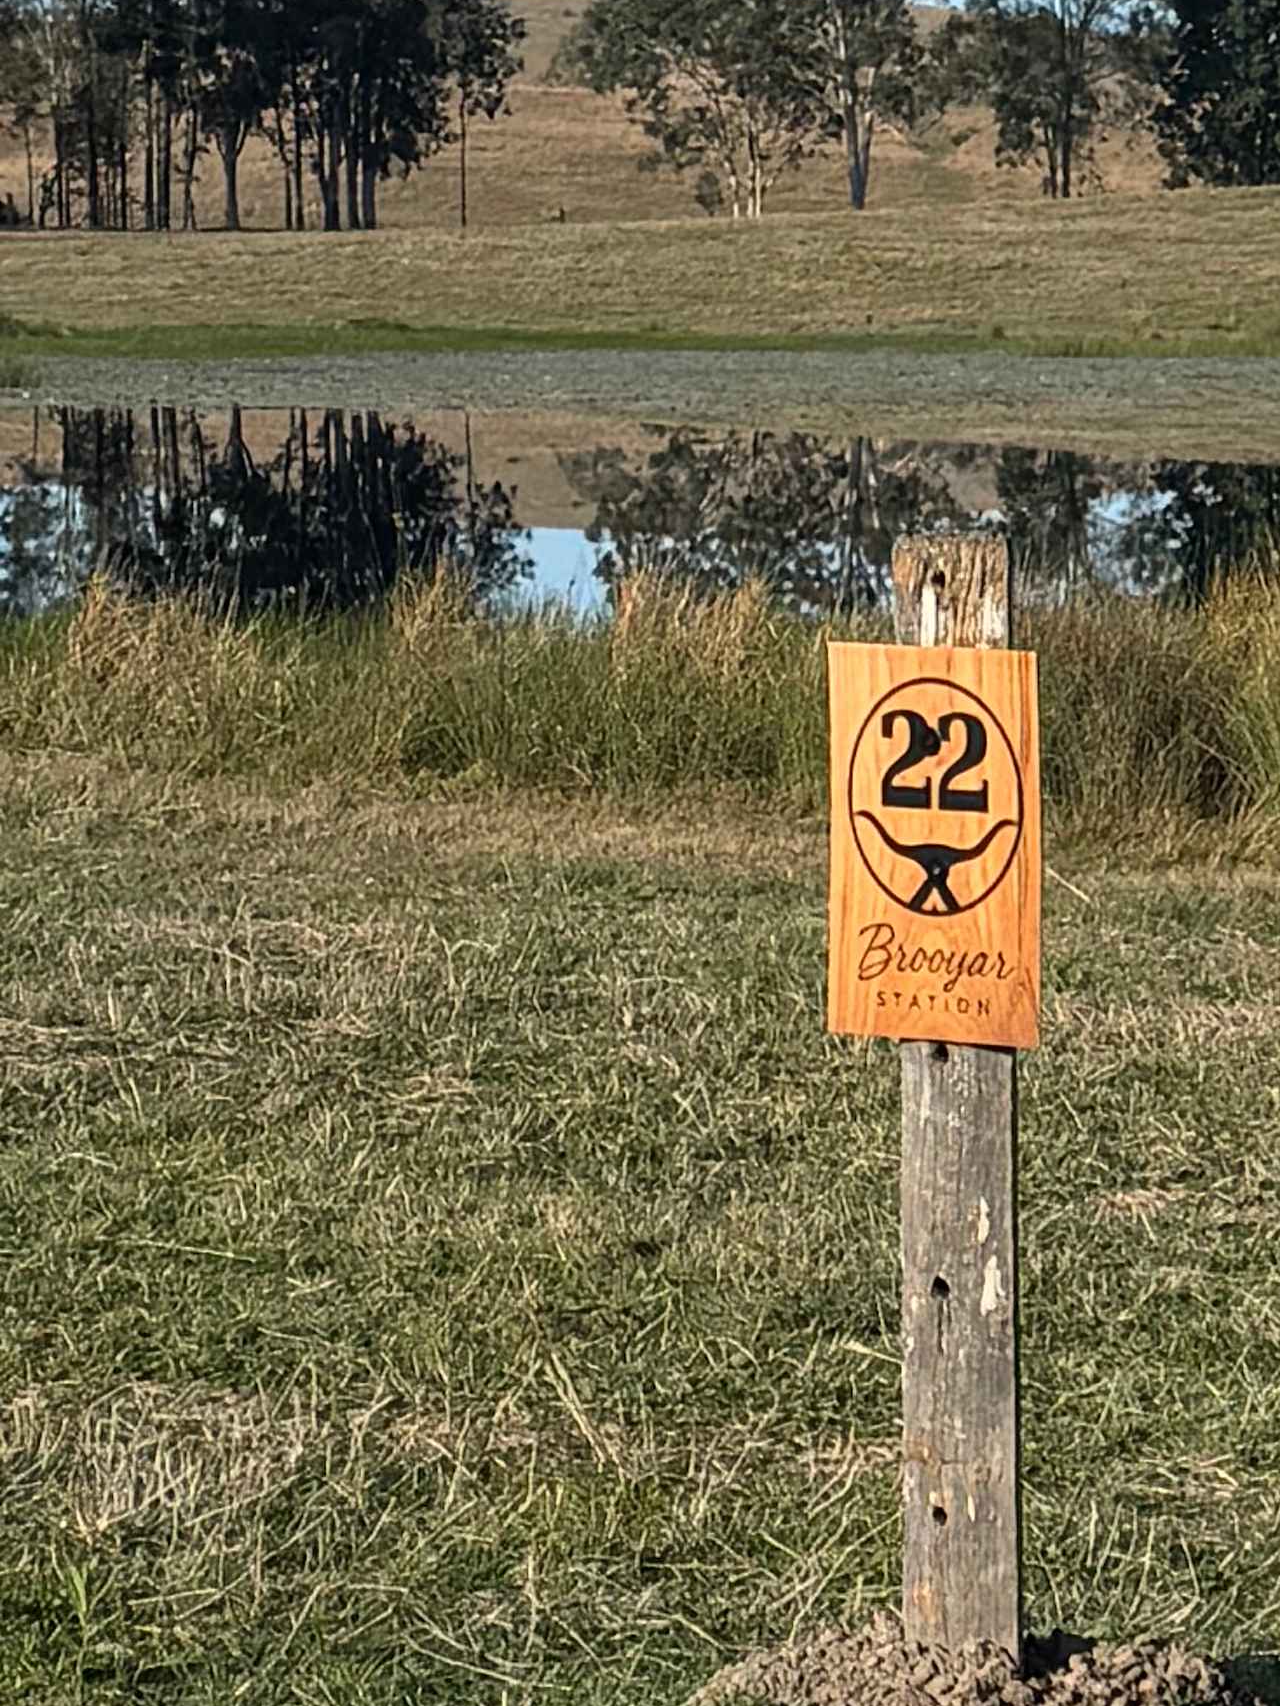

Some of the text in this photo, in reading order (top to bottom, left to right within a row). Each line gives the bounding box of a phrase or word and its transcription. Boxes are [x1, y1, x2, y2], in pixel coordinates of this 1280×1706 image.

[881, 709, 989, 813] 22
[856, 922, 1016, 993] Brooyar
[876, 990, 991, 1018] STATION
